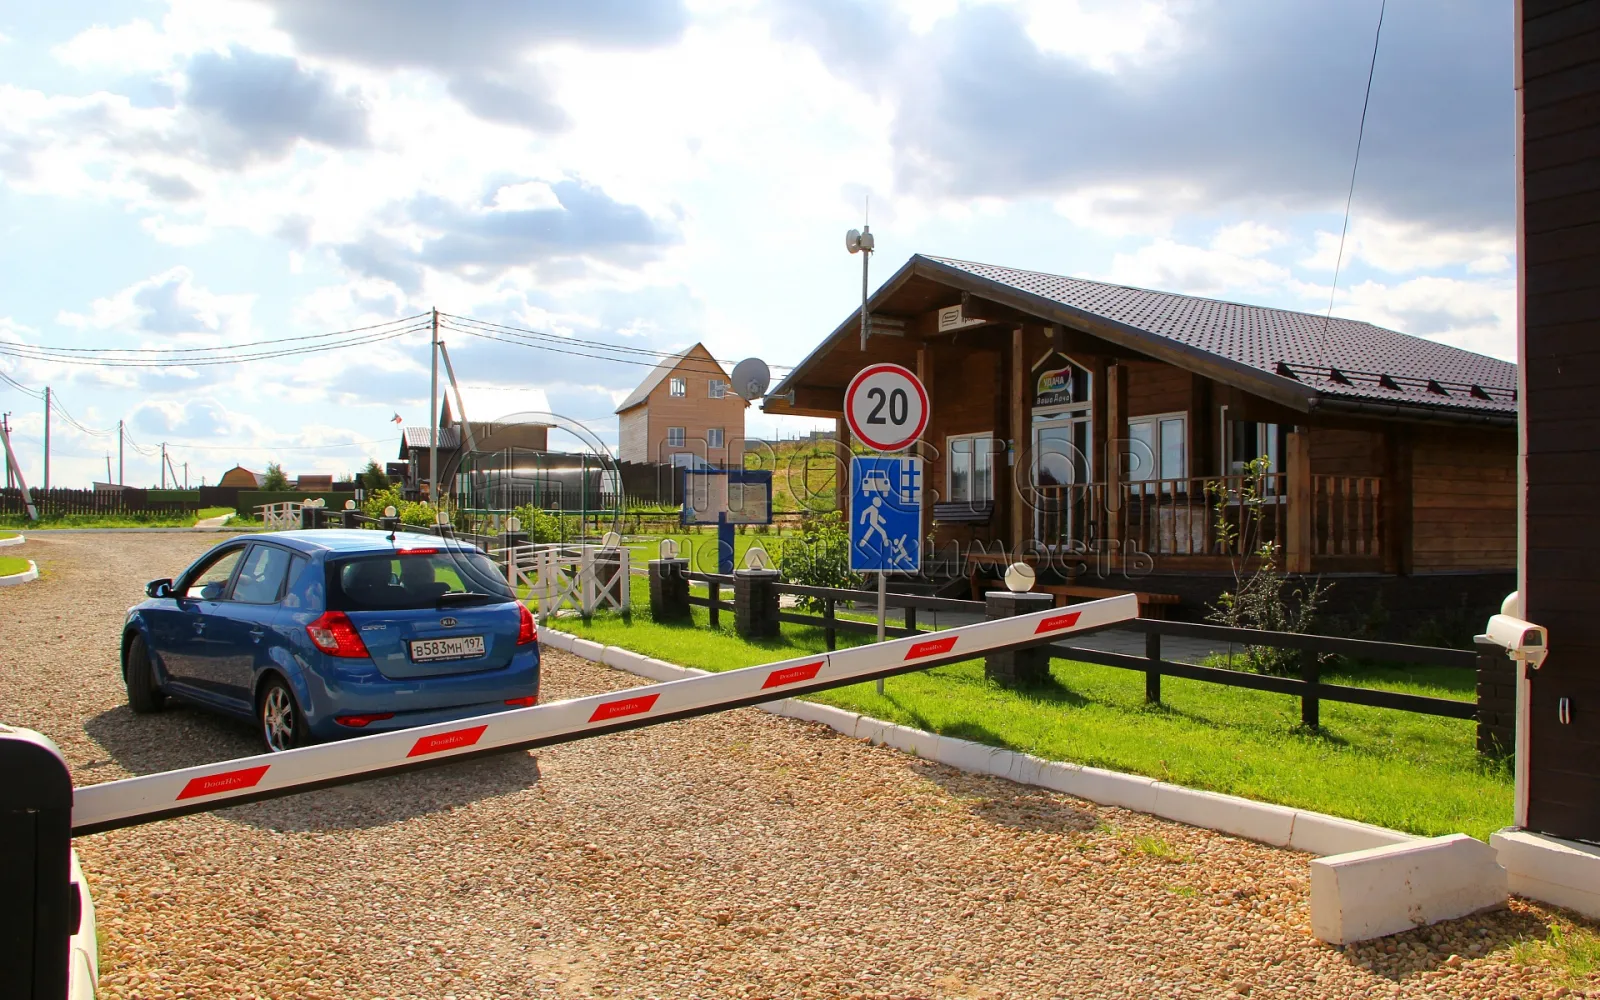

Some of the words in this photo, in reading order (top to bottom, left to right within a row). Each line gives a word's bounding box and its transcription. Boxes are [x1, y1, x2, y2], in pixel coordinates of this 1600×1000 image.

[1044, 376, 1064, 387] УДАЧА
[866, 387, 908, 425] 20
[464, 638, 481, 648] 197
